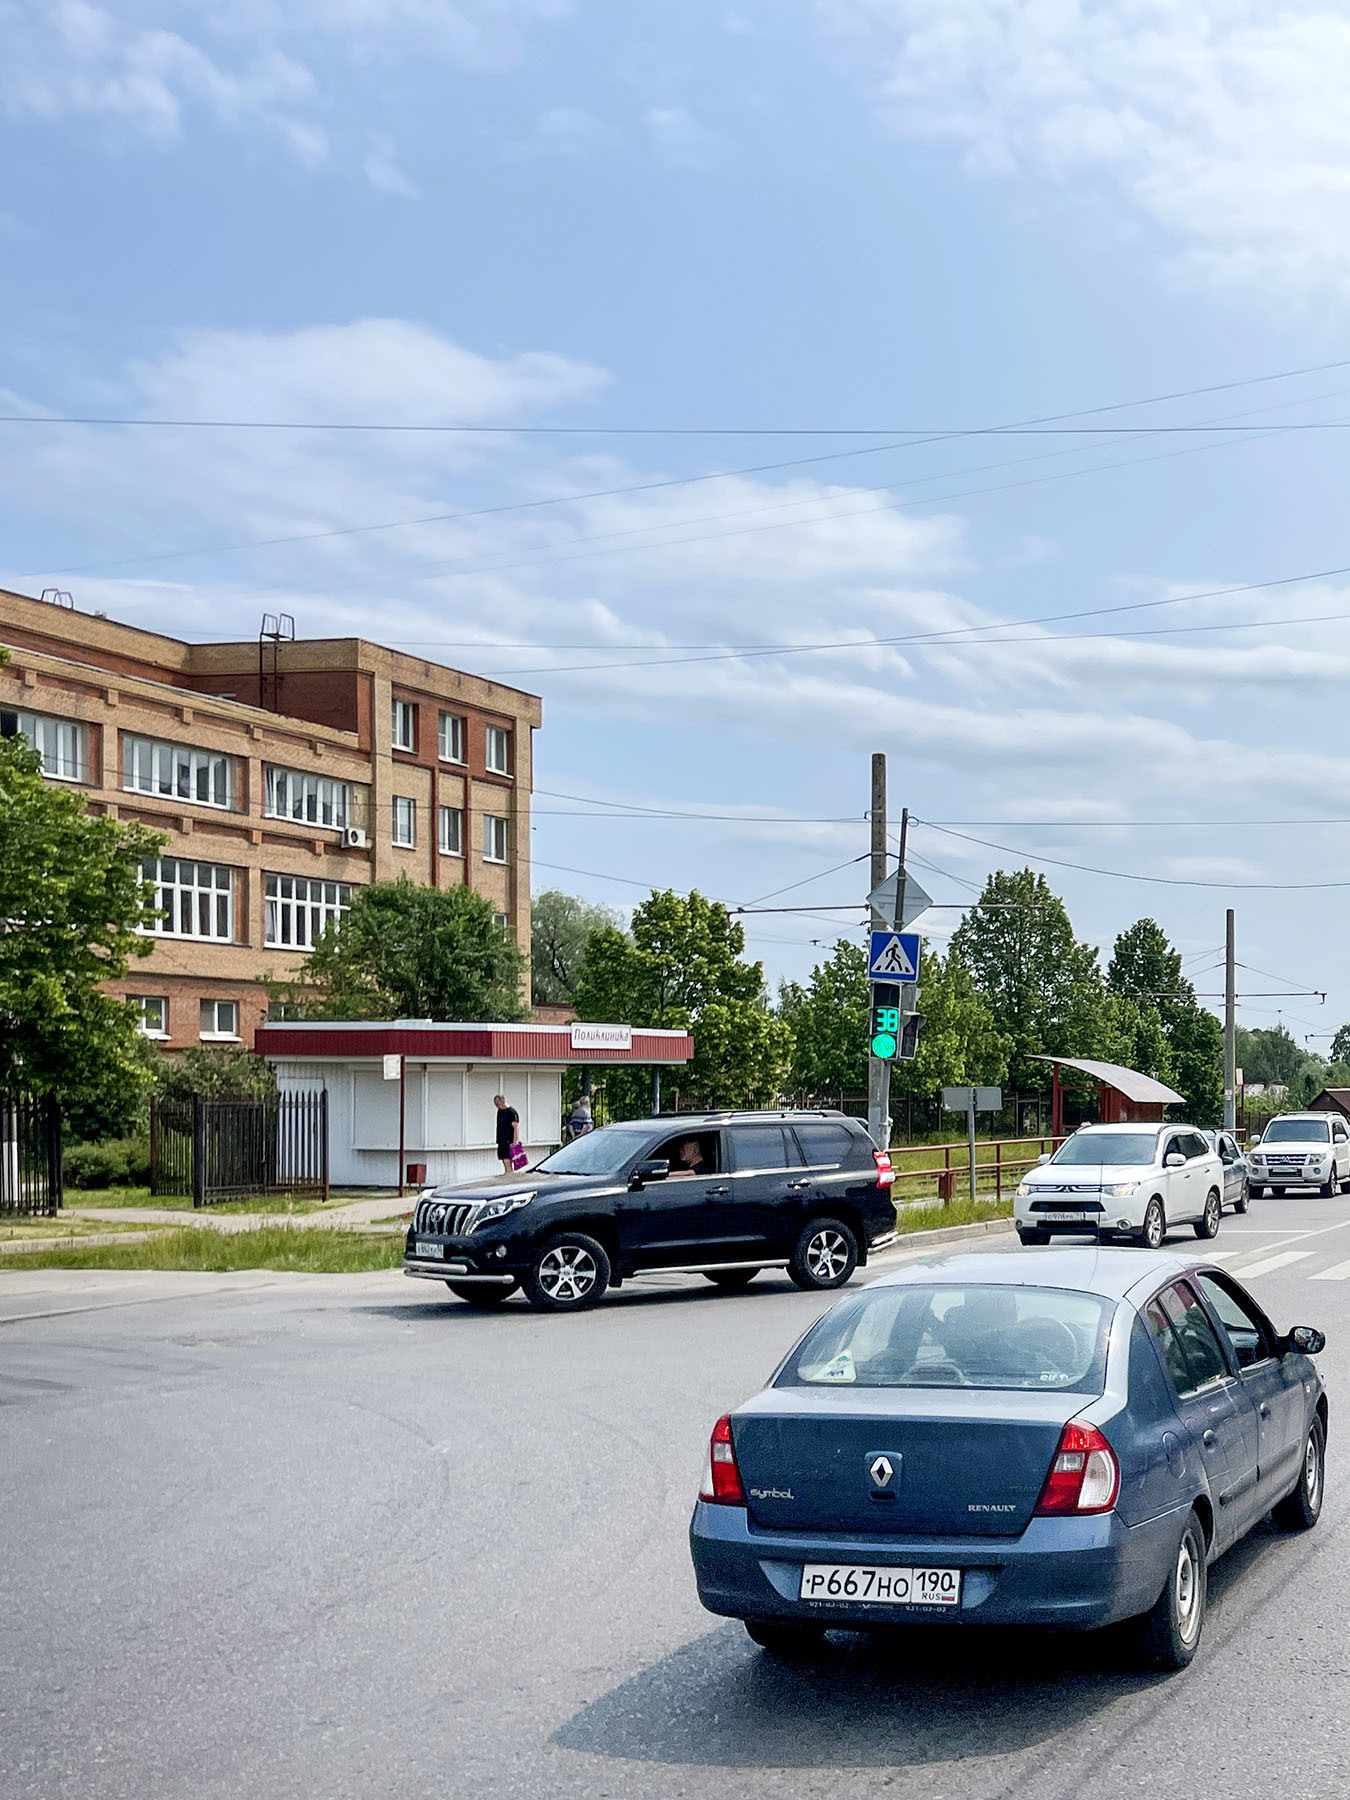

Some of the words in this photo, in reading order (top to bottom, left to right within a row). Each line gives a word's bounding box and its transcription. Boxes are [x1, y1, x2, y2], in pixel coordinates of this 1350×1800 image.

[877, 1009, 898, 1032] 38
[574, 1028, 629, 1042] Поликлиника
[751, 1488, 794, 1500] symbol
[968, 1504, 1016, 1512] RENAULT
[916, 1571, 953, 1592] 190
[921, 1592, 941, 1601] RUS
